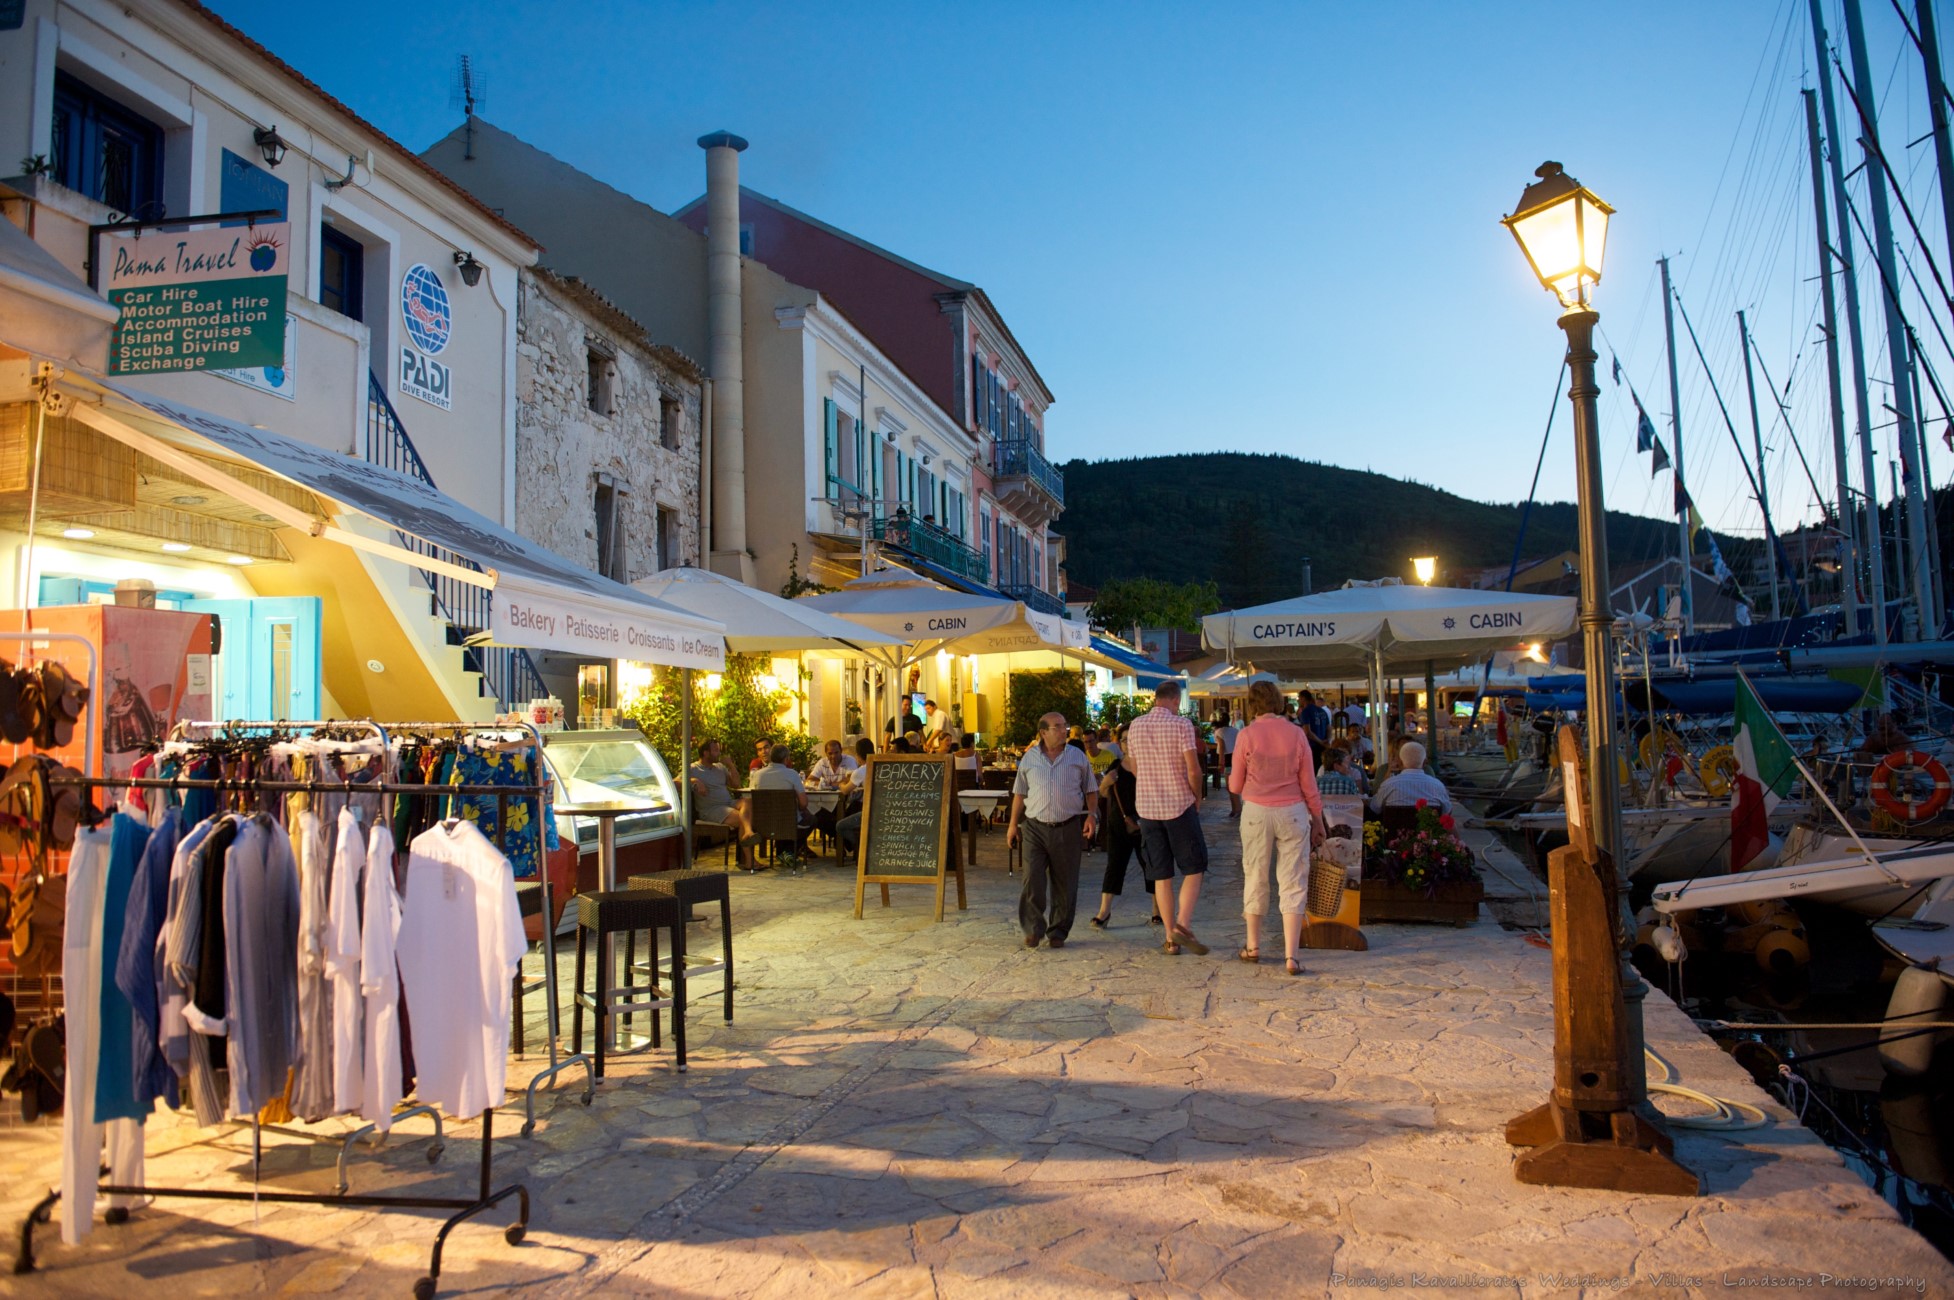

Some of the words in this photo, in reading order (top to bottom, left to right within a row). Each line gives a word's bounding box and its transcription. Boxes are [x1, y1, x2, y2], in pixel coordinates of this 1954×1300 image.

[113, 246, 166, 281] Pama
[175, 237, 240, 274] Travel
[123, 292, 153, 305] Car
[162, 288, 198, 301] Hire
[122, 304, 172, 318] Motor
[182, 299, 222, 314] Boat
[232, 296, 269, 309] Hire
[122, 311, 267, 332] Accommodation
[120, 329, 174, 345] Island
[182, 325, 252, 340] Cruises
[120, 343, 174, 359] Scuba
[182, 340, 240, 354] Diving
[120, 356, 206, 372] Exchange
[239, 370, 256, 382] Hire
[403, 348, 450, 399] PADI
[402, 382, 420, 397] DIVE
[422, 391, 450, 409] RESORT
[510, 604, 556, 637] Bakery
[566, 615, 619, 643] Patisserie
[627, 627, 676, 652] Croissants
[681, 636, 694, 654] Ice
[695, 639, 720, 658] Cream
[928, 617, 967, 631] CABIN
[1253, 622, 1336, 639] CAPTAIN'S
[1469, 612, 1522, 629] CABIN
[879, 763, 942, 781] BAKERY
[903, 792, 940, 800] CREAMS
[919, 843, 933, 852] PIE
[919, 850, 930, 859] PIE
[917, 860, 937, 869] JUICE
